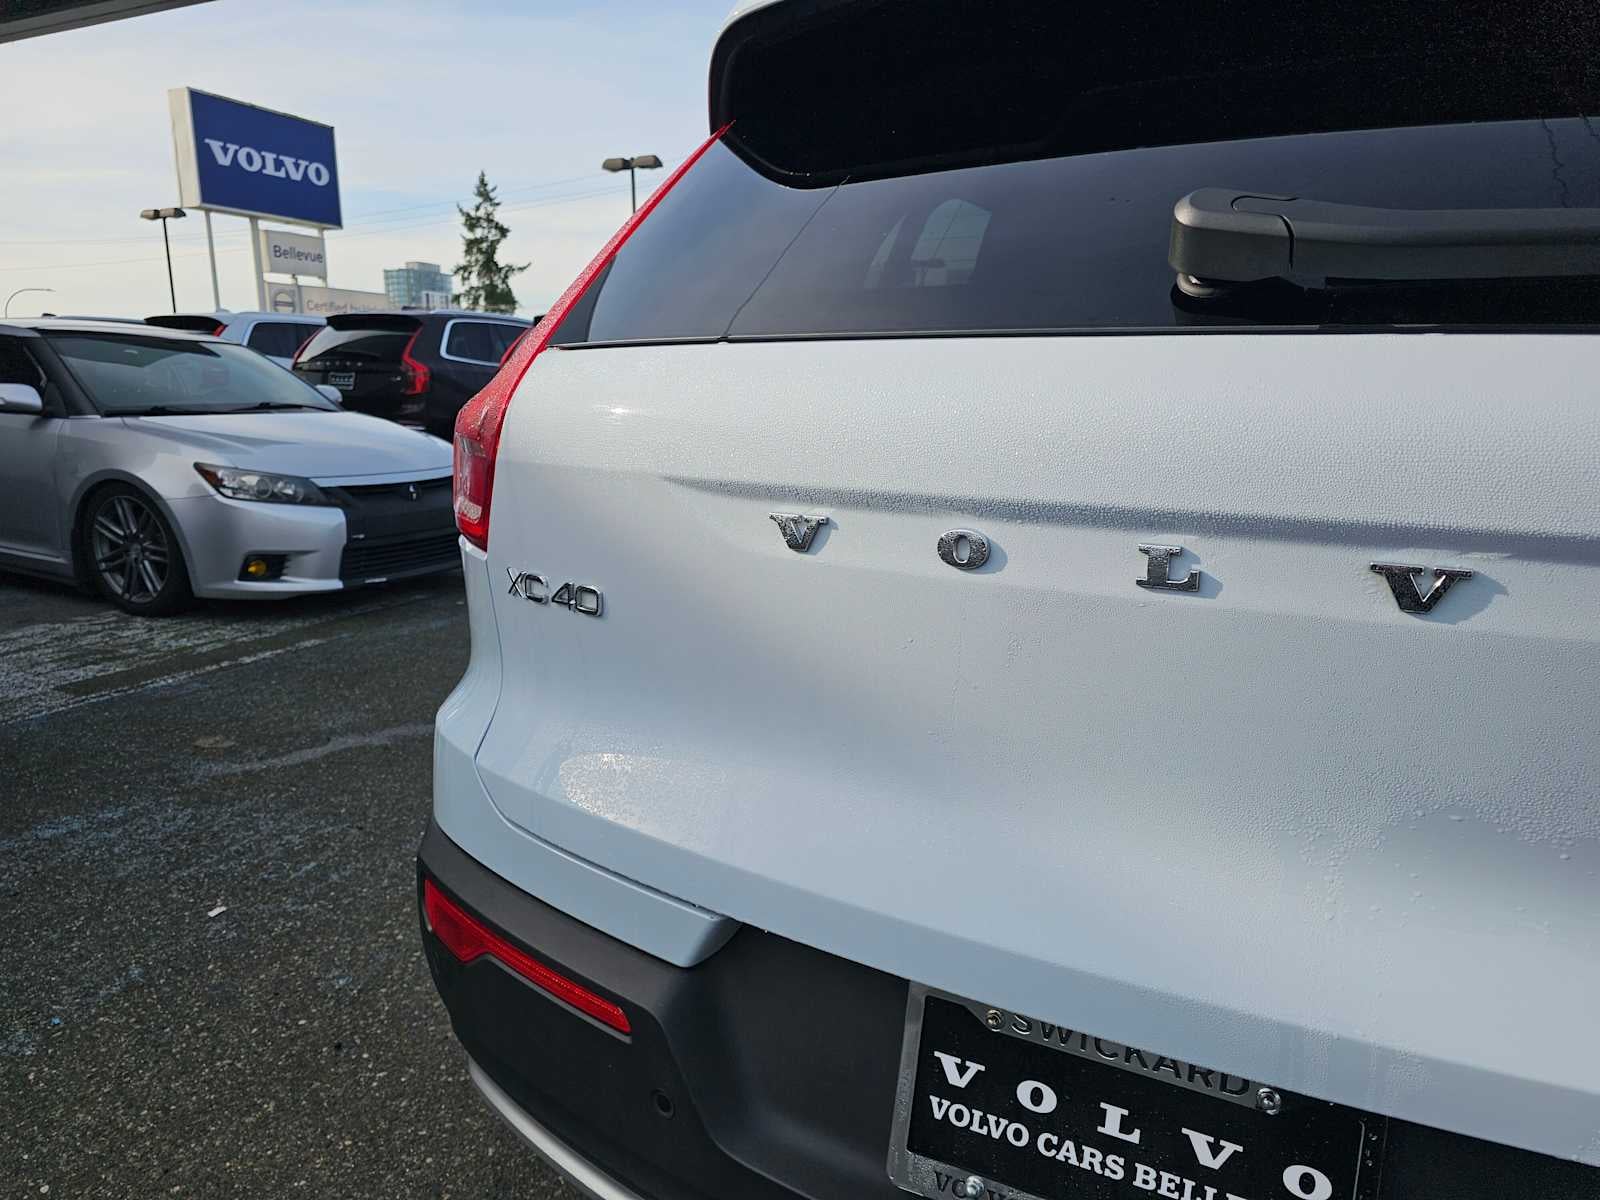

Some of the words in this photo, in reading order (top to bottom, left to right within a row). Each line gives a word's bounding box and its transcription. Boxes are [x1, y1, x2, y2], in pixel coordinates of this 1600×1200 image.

[204, 138, 330, 186] VOLVO
[273, 244, 323, 263] Bellevue
[506, 566, 603, 616] XC40
[1011, 1014, 1250, 1096] SWICKARD
[929, 1095, 1030, 1147] VOLVO
[1037, 1132, 1126, 1181] CARS
[934, 1051, 1333, 1200] VOLVO
